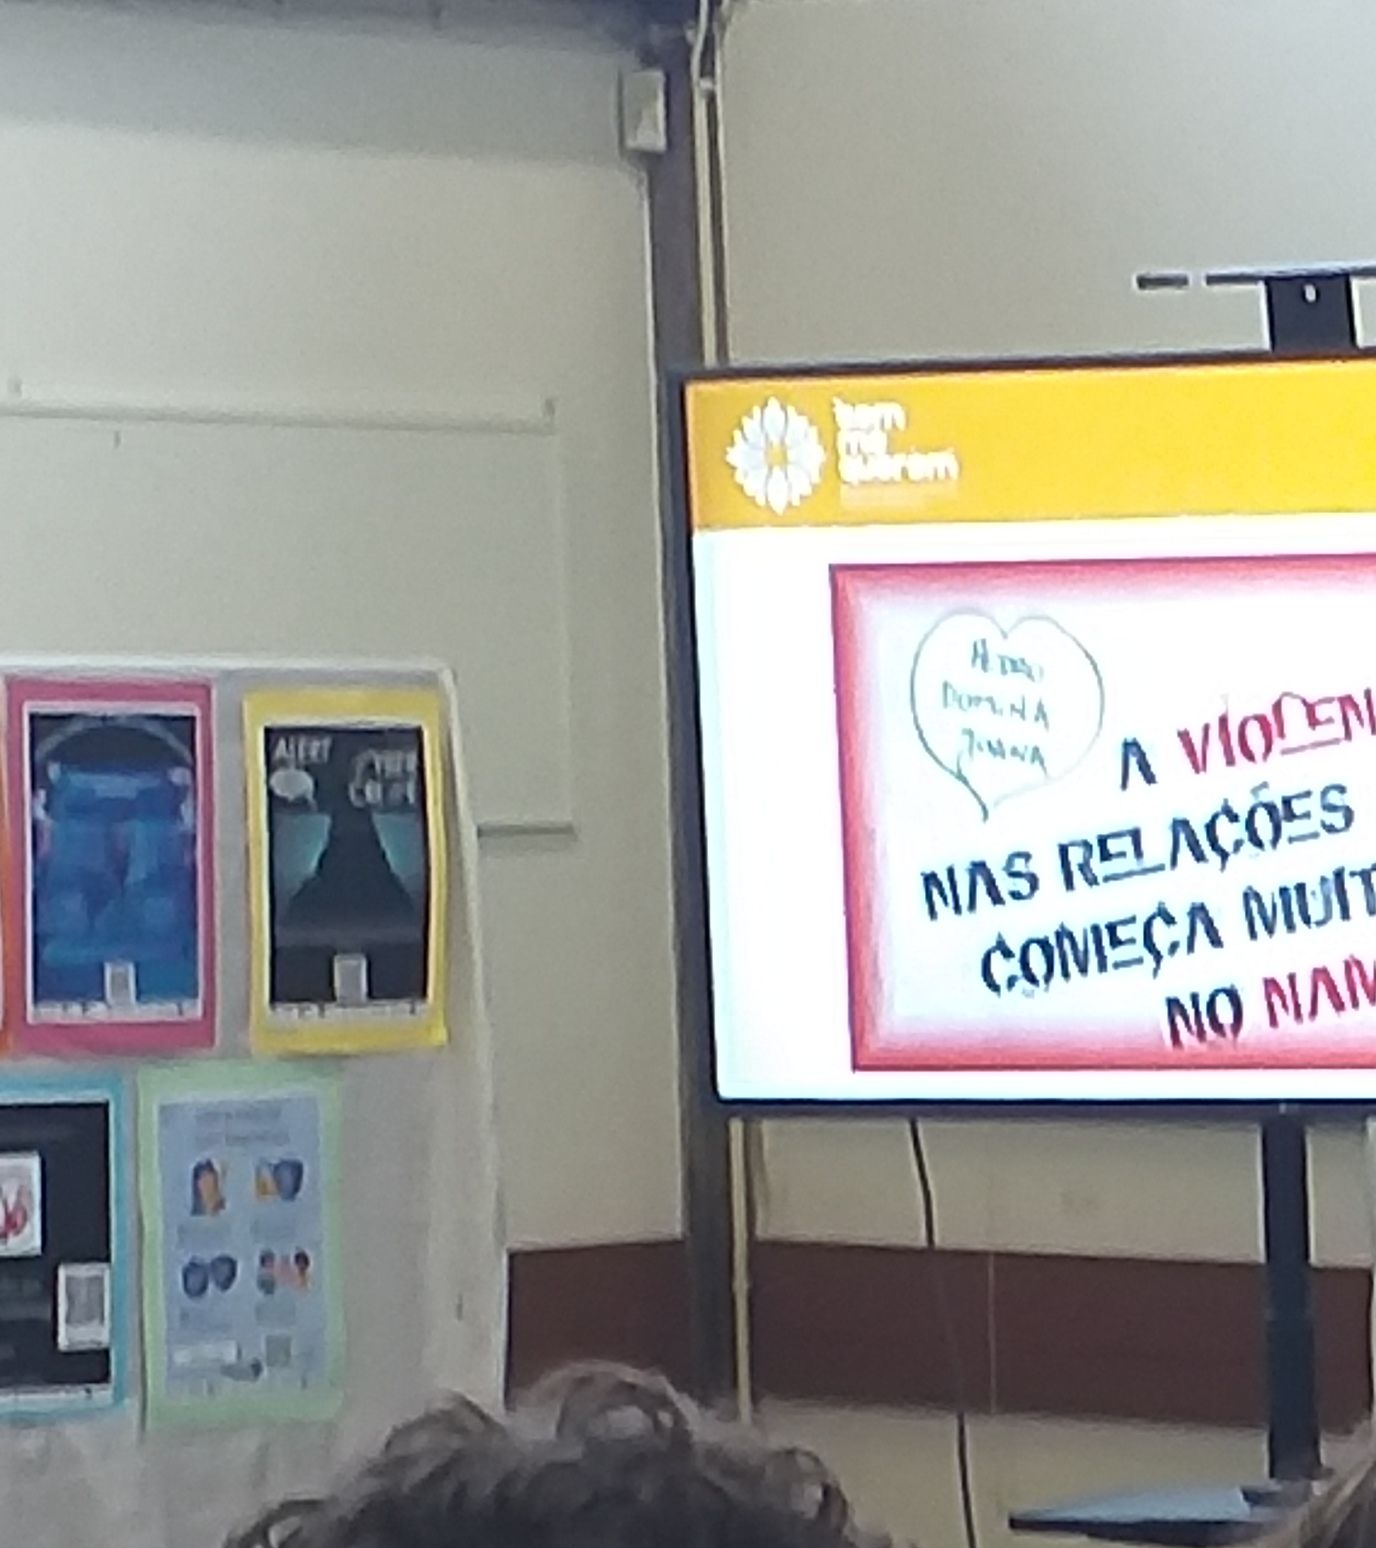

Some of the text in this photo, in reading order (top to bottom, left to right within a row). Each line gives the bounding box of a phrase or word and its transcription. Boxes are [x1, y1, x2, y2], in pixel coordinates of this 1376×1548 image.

[1120, 737, 1157, 791] A
[921, 850, 1039, 921] NAS
[980, 901, 1224, 997] COMEÇA
[1165, 983, 1244, 1051] NO
